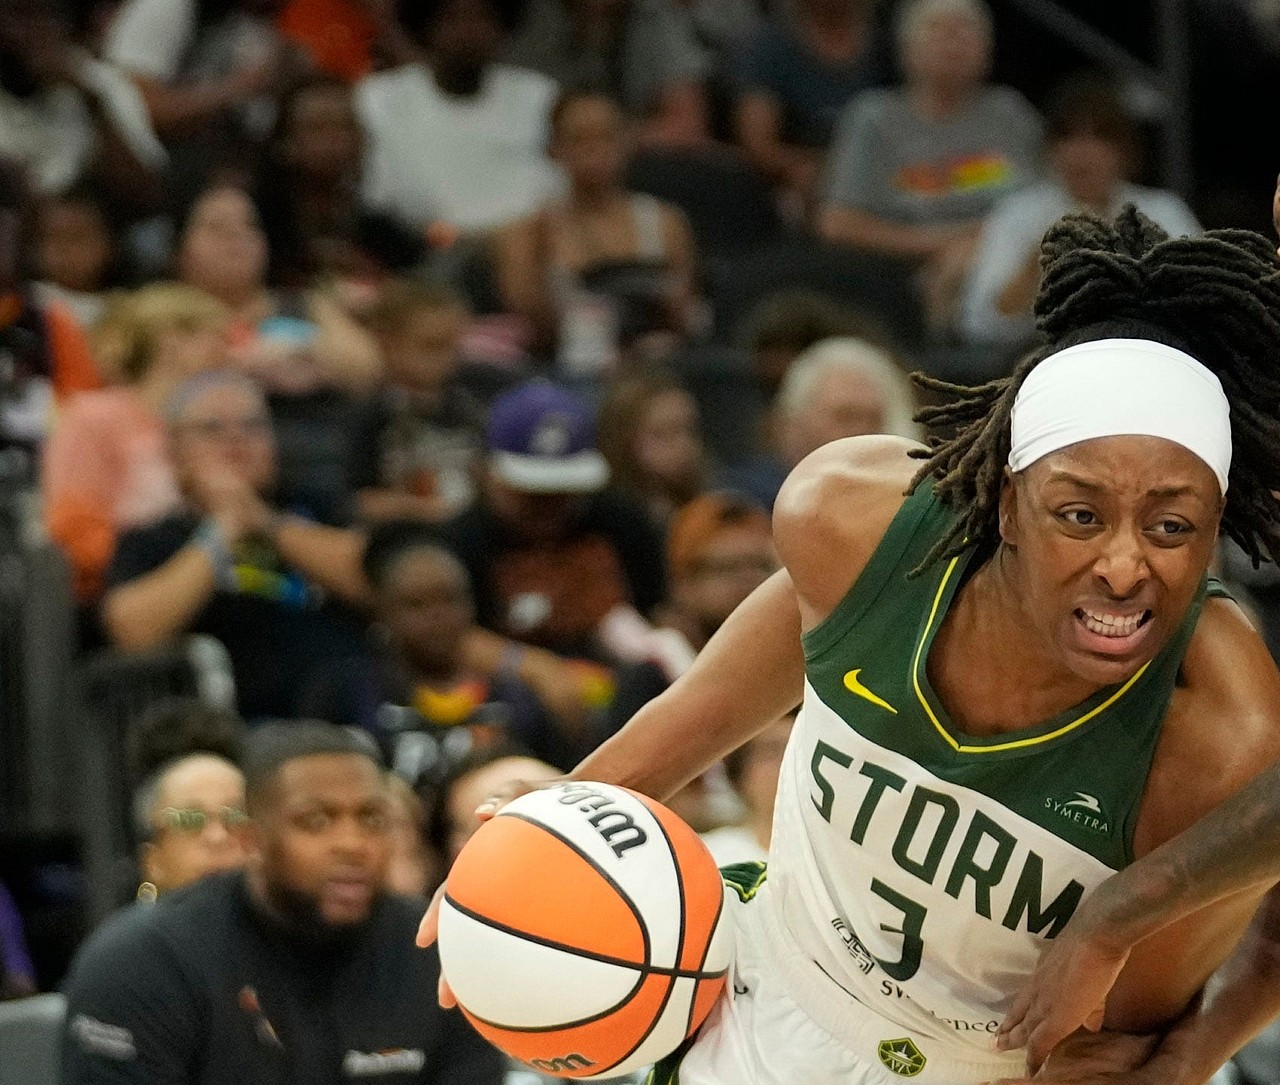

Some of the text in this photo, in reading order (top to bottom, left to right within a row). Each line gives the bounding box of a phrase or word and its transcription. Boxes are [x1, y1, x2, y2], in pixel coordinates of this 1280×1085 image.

[811, 739, 1085, 940] STORM
[1044, 797, 1109, 833] SYMETRA
[871, 877, 928, 982] 3
